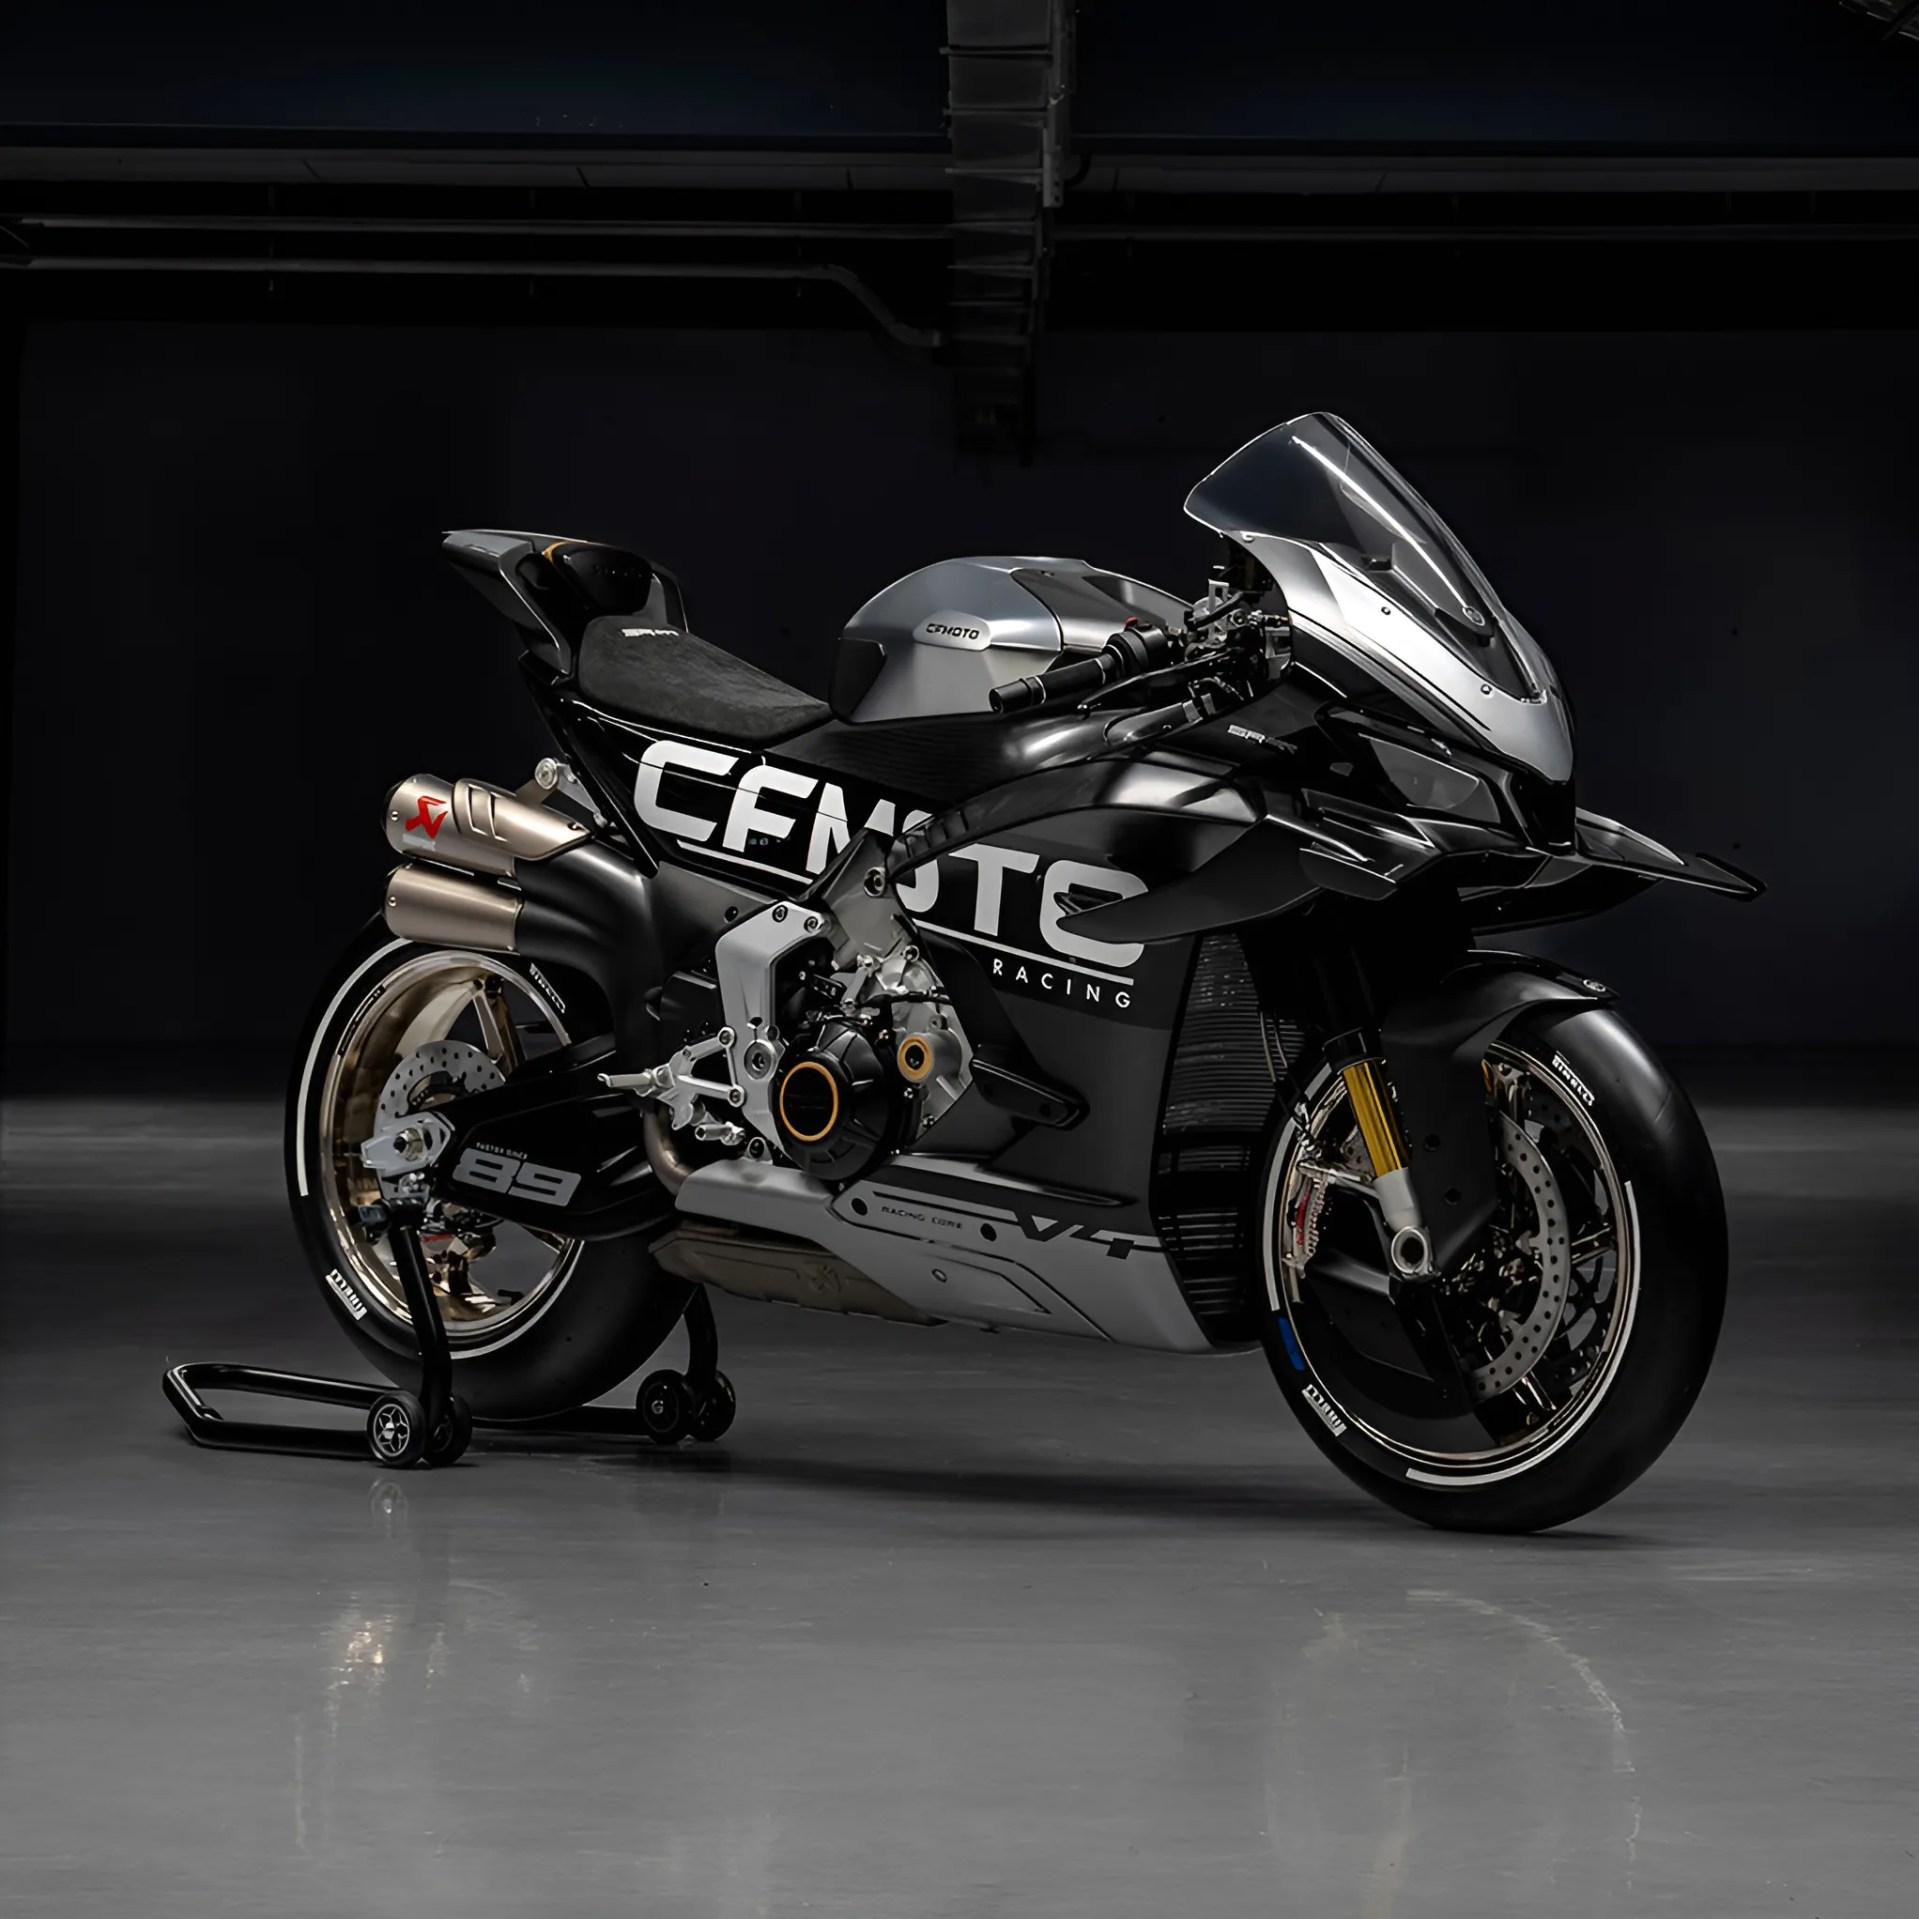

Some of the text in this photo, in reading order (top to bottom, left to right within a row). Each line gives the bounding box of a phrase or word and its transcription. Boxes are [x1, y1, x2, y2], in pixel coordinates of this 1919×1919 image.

[925, 623, 980, 640] CFMOTO
[993, 957, 1131, 1009] RACING
[452, 1147, 582, 1207] 89
